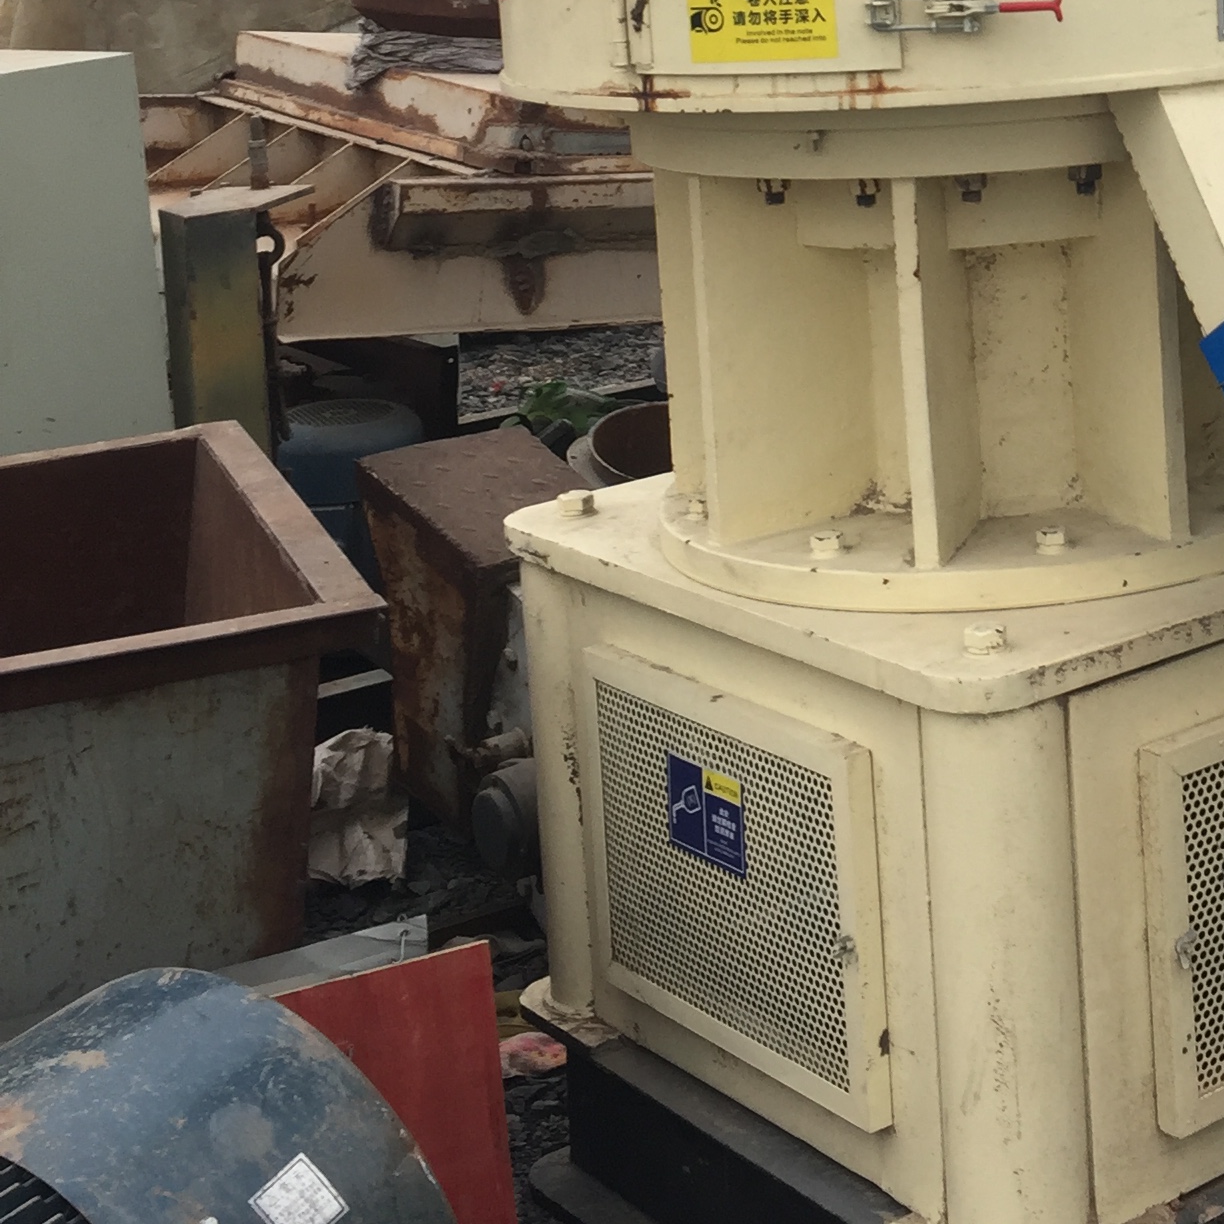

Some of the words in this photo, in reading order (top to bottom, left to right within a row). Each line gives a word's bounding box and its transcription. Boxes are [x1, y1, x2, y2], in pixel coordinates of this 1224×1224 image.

[732, 8, 827, 26] 请勿将手深入
